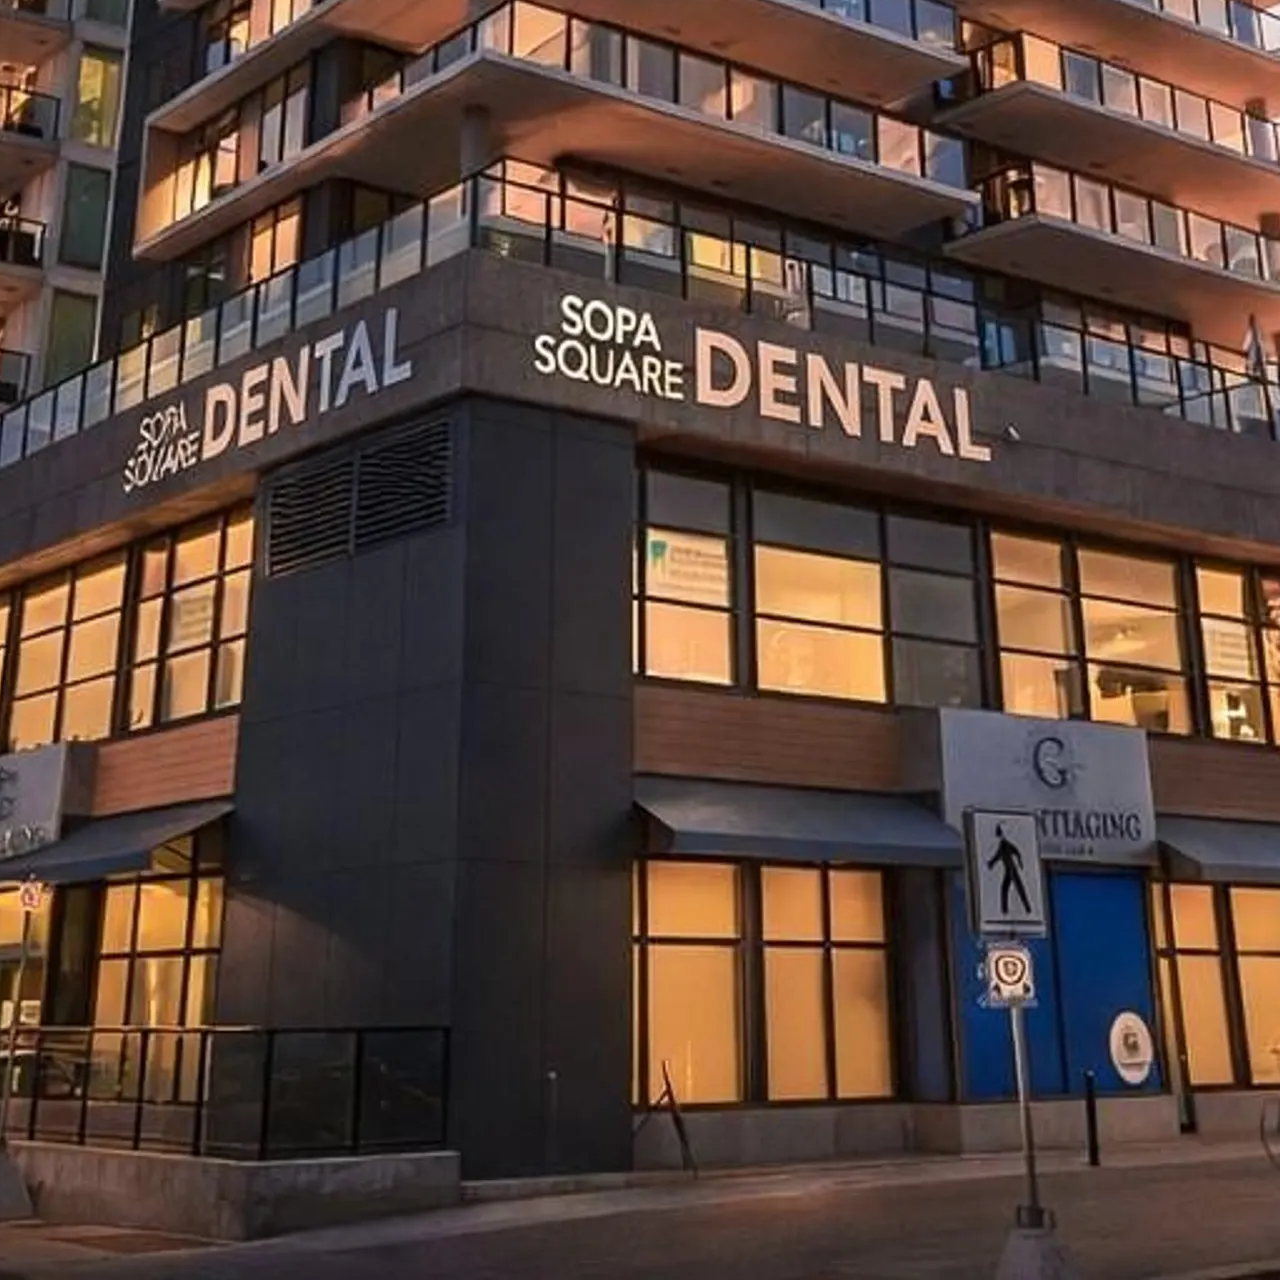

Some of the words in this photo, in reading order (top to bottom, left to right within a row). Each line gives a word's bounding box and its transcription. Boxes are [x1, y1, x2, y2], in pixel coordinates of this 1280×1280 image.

[534, 334, 685, 401] SQUARE
[561, 294, 662, 352] SOPA
[200, 307, 413, 462] DENTAL
[695, 326, 992, 462] DENTAL
